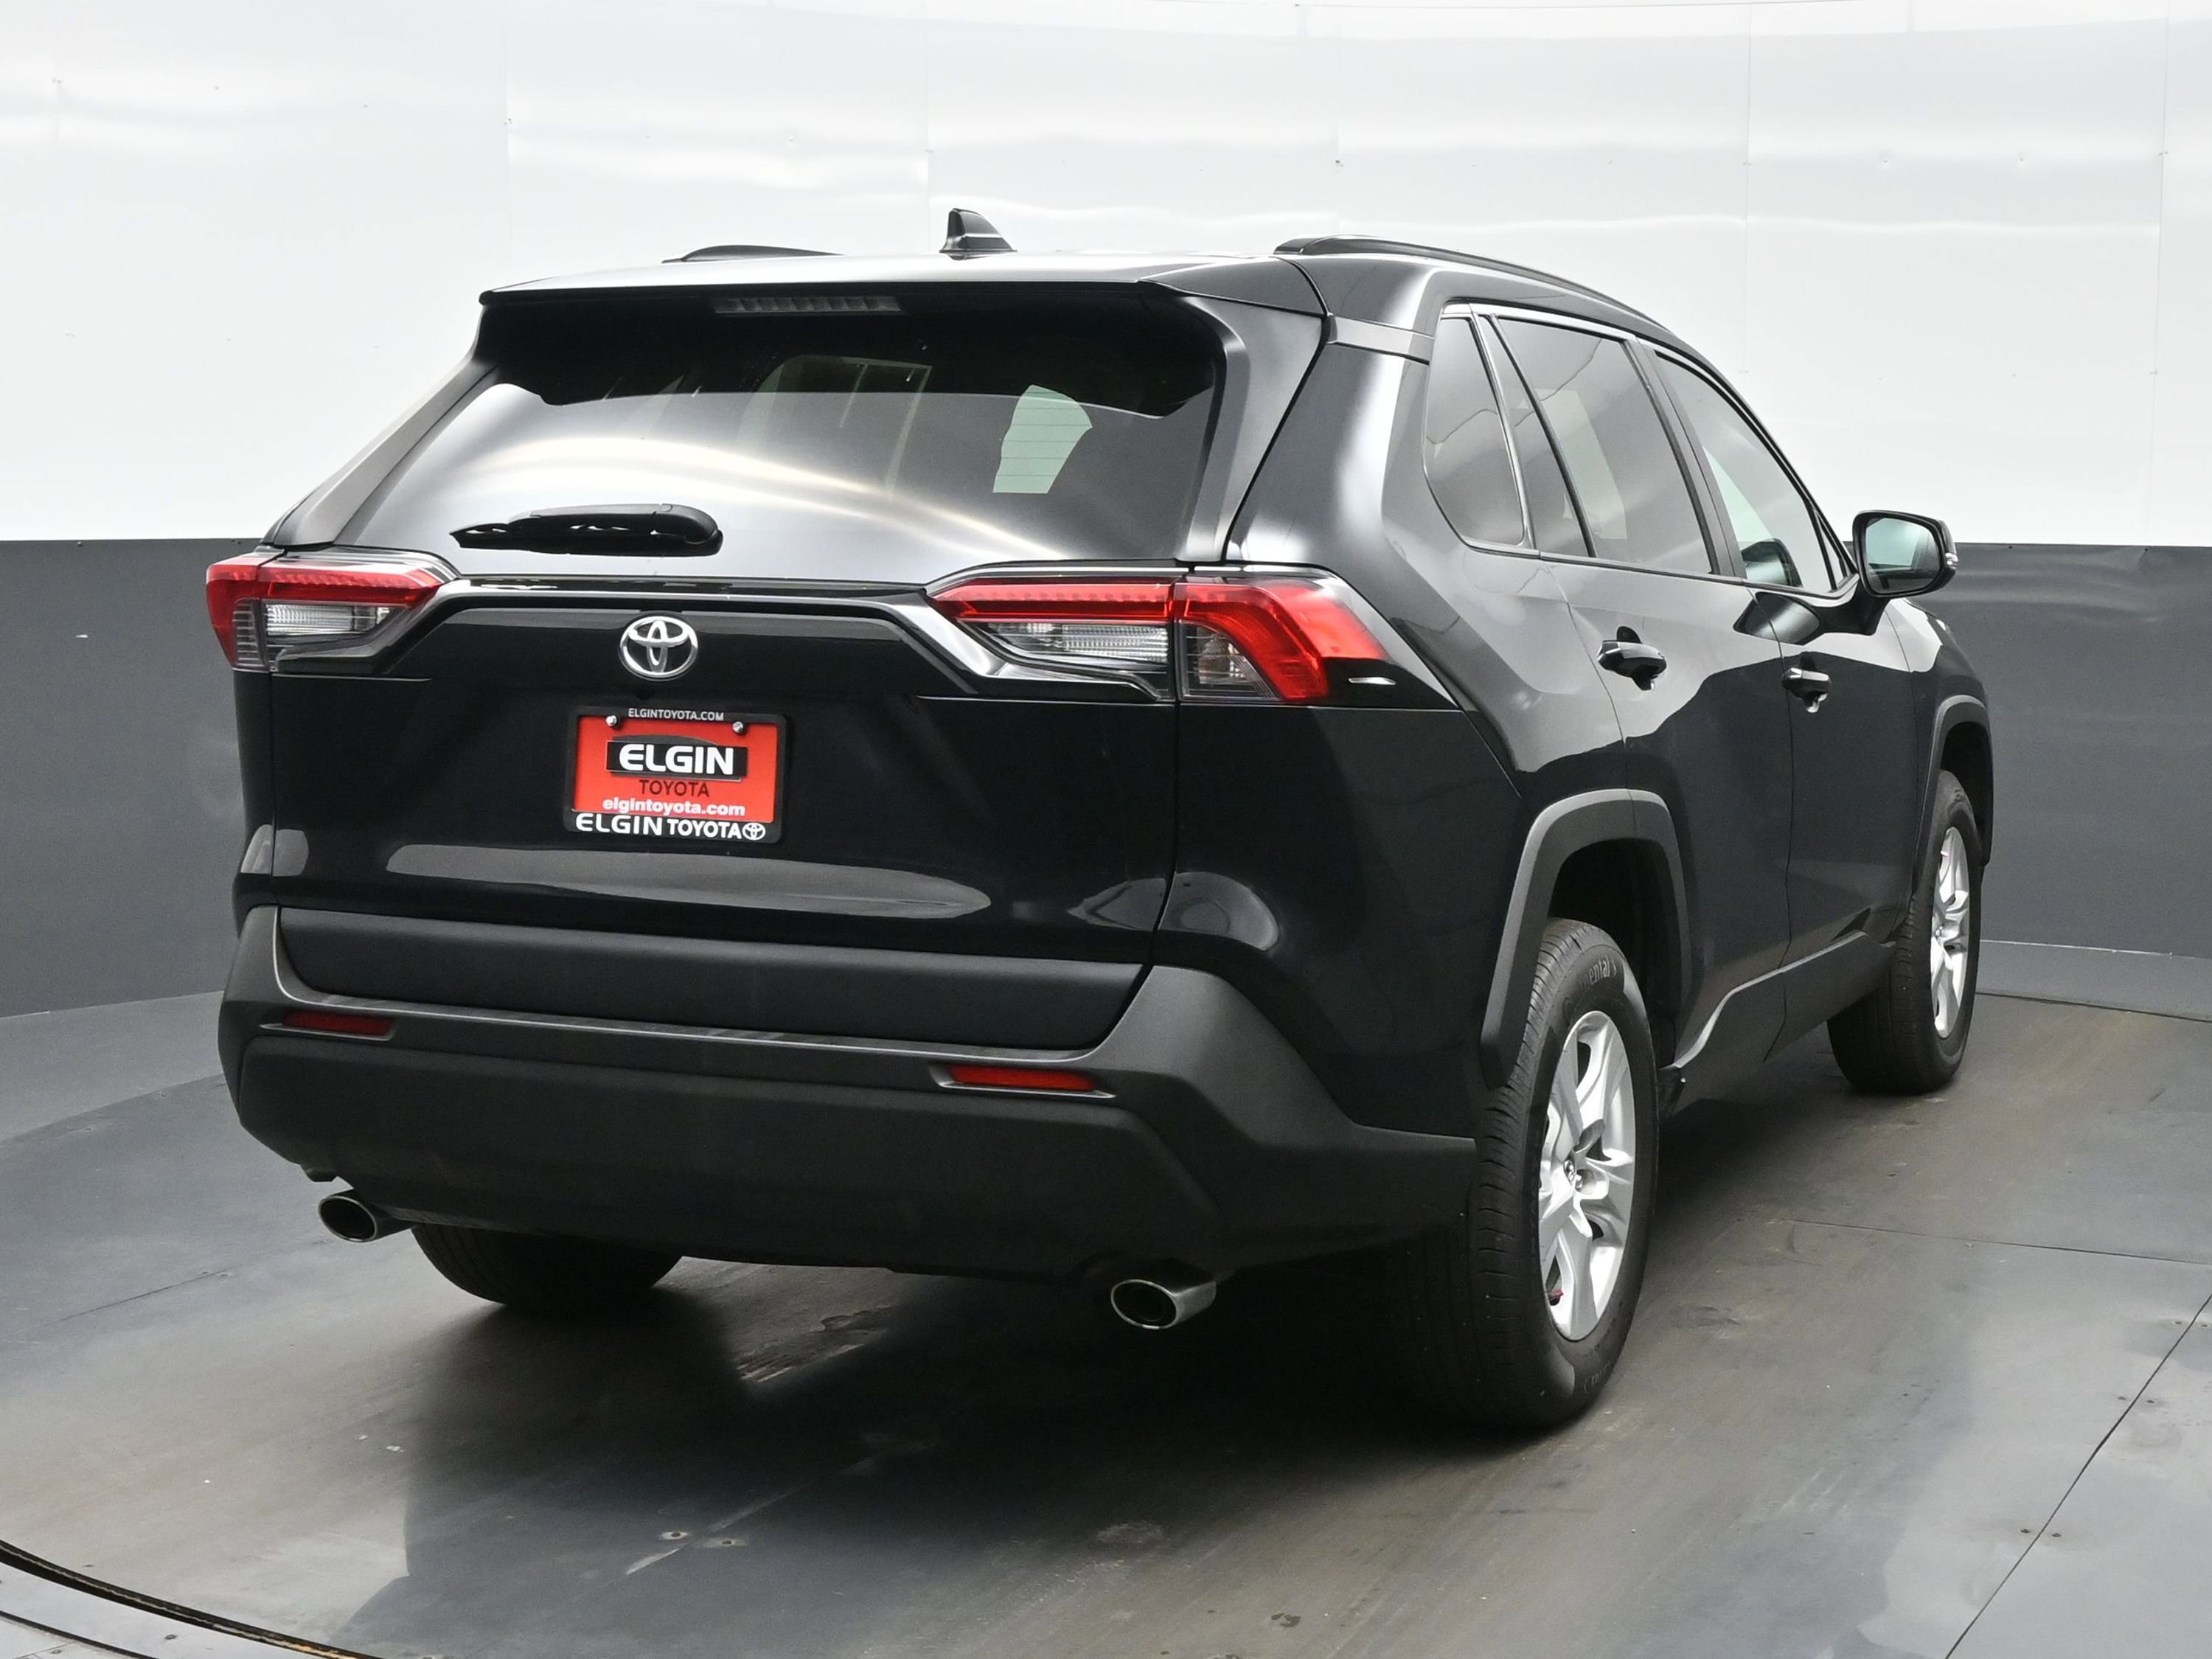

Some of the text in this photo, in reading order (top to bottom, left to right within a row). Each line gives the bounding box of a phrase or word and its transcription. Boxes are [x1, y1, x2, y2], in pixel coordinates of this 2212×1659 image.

[628, 708, 724, 720] ELGINTOYOTA.COM
[619, 744, 734, 774] ELGIN
[639, 779, 710, 797] TOYOTA
[602, 797, 745, 817] elgintoyota.com
[576, 813, 742, 839] ELGIN TOYOTA
